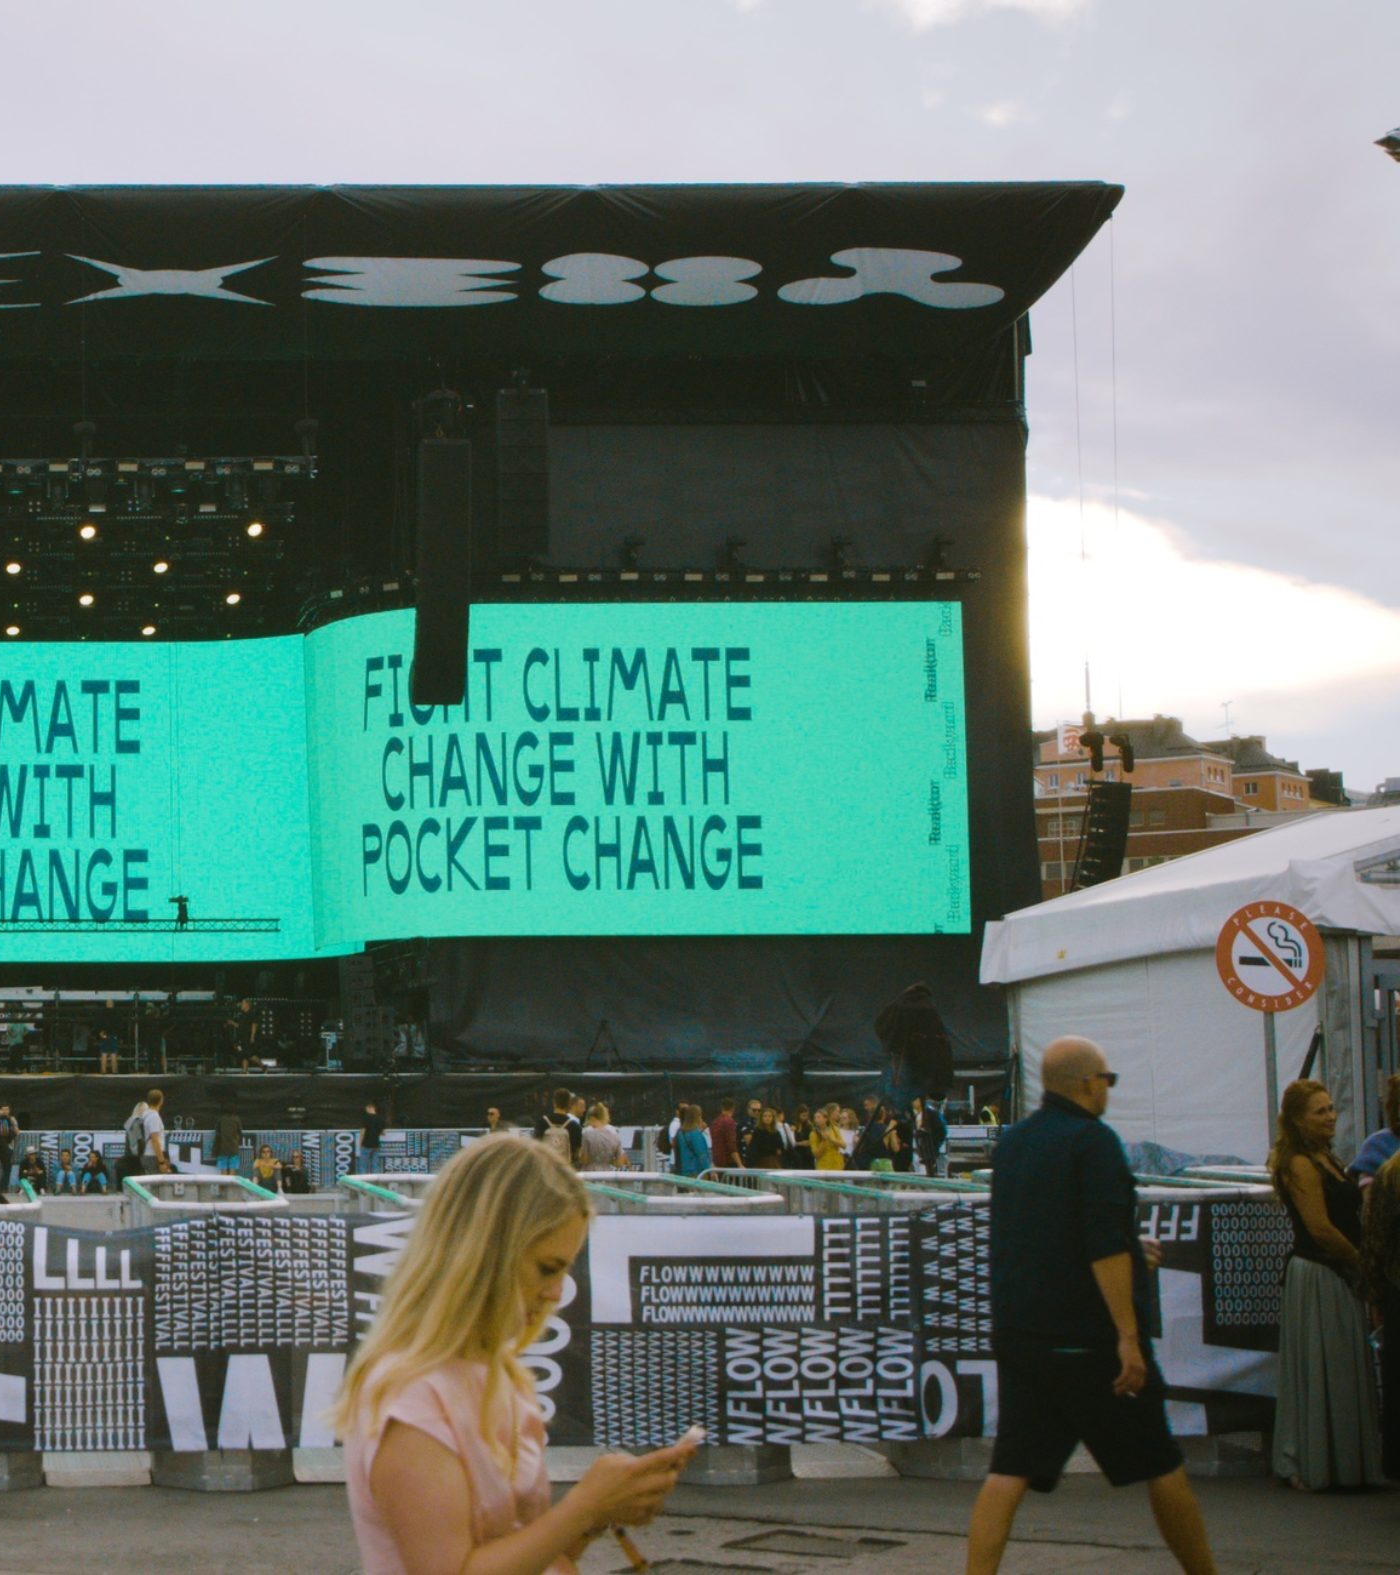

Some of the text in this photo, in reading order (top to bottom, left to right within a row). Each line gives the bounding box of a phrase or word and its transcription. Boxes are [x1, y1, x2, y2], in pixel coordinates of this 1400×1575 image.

[363, 647, 752, 732] FIT CLIMATE
[381, 731, 730, 811] CHANGE WITH
[362, 814, 764, 897] POCKET CHANGE
[1232, 904, 1309, 930] PLEASE
[1227, 976, 1314, 1009] CONSIDER
